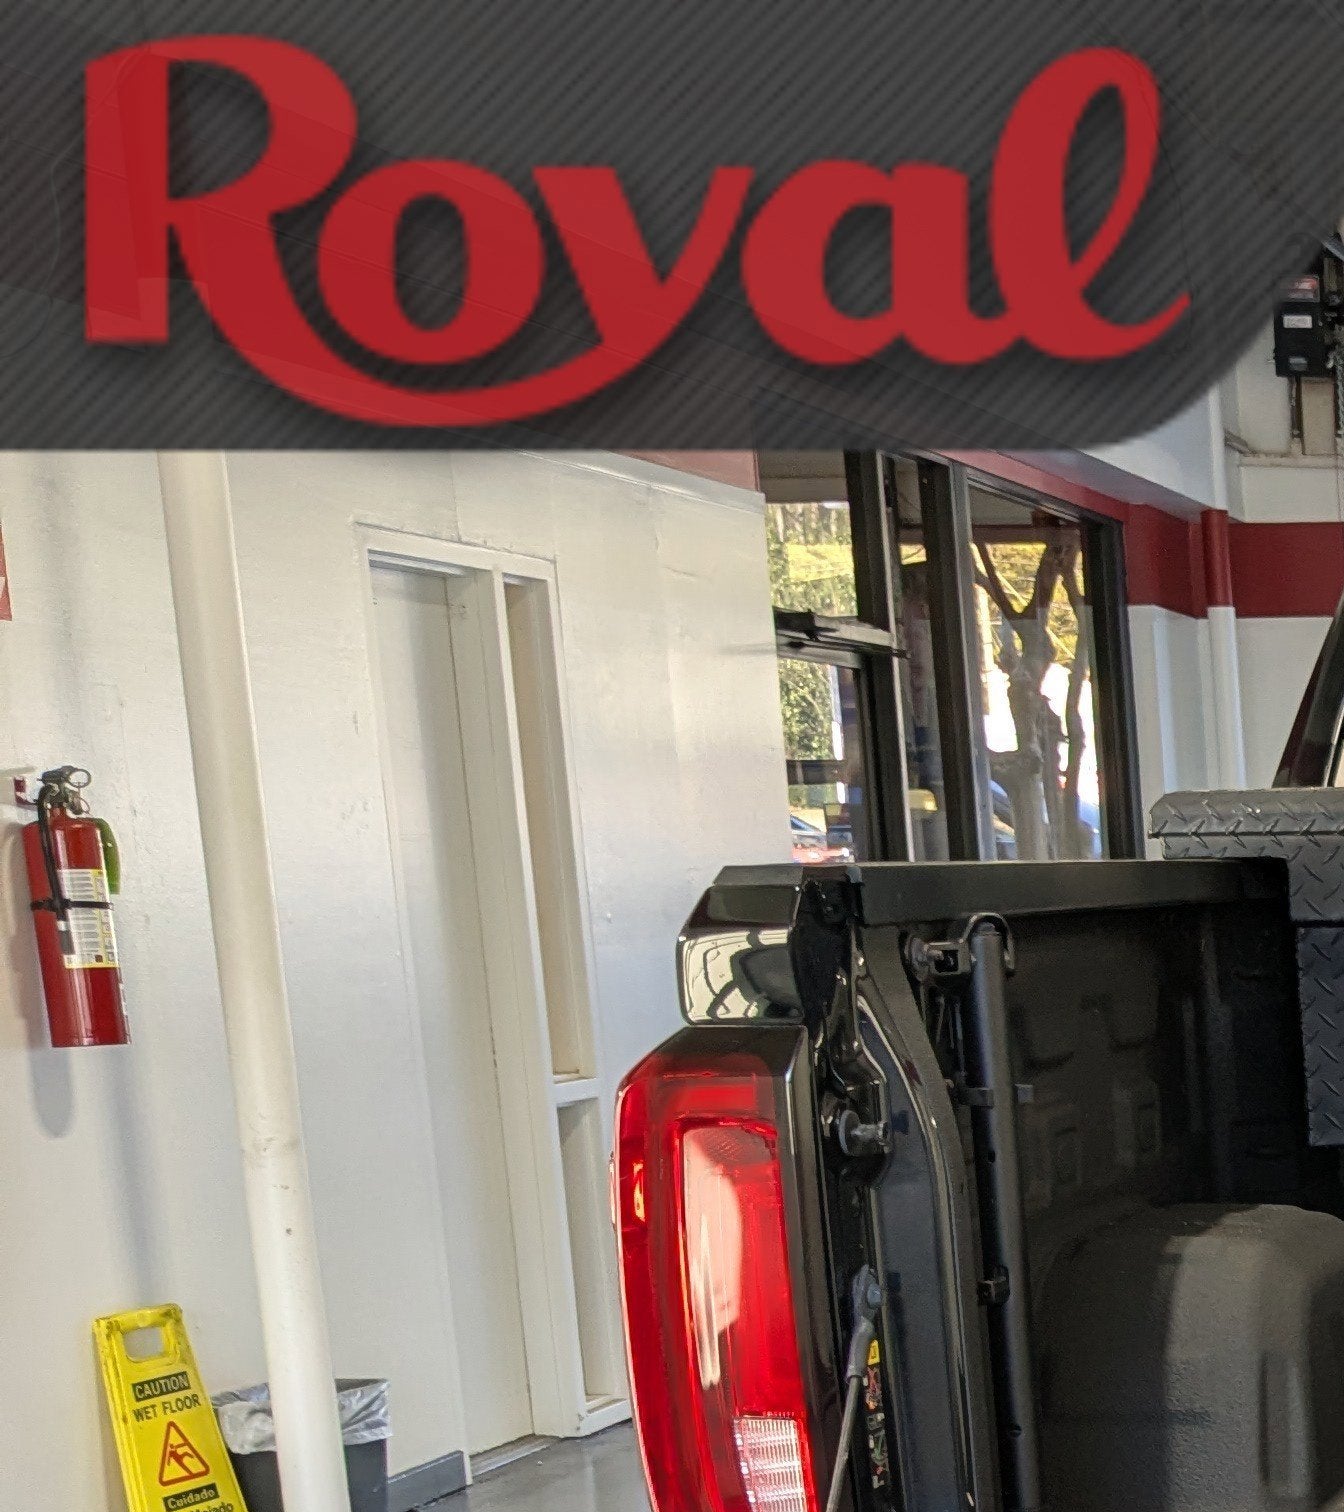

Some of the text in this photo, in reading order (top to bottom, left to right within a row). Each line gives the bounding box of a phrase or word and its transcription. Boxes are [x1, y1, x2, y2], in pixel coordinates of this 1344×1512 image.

[134, 1374, 189, 1399] CAUTION
[133, 1393, 202, 1422] WET FLOOR
[167, 1487, 215, 1509] Cuidado
